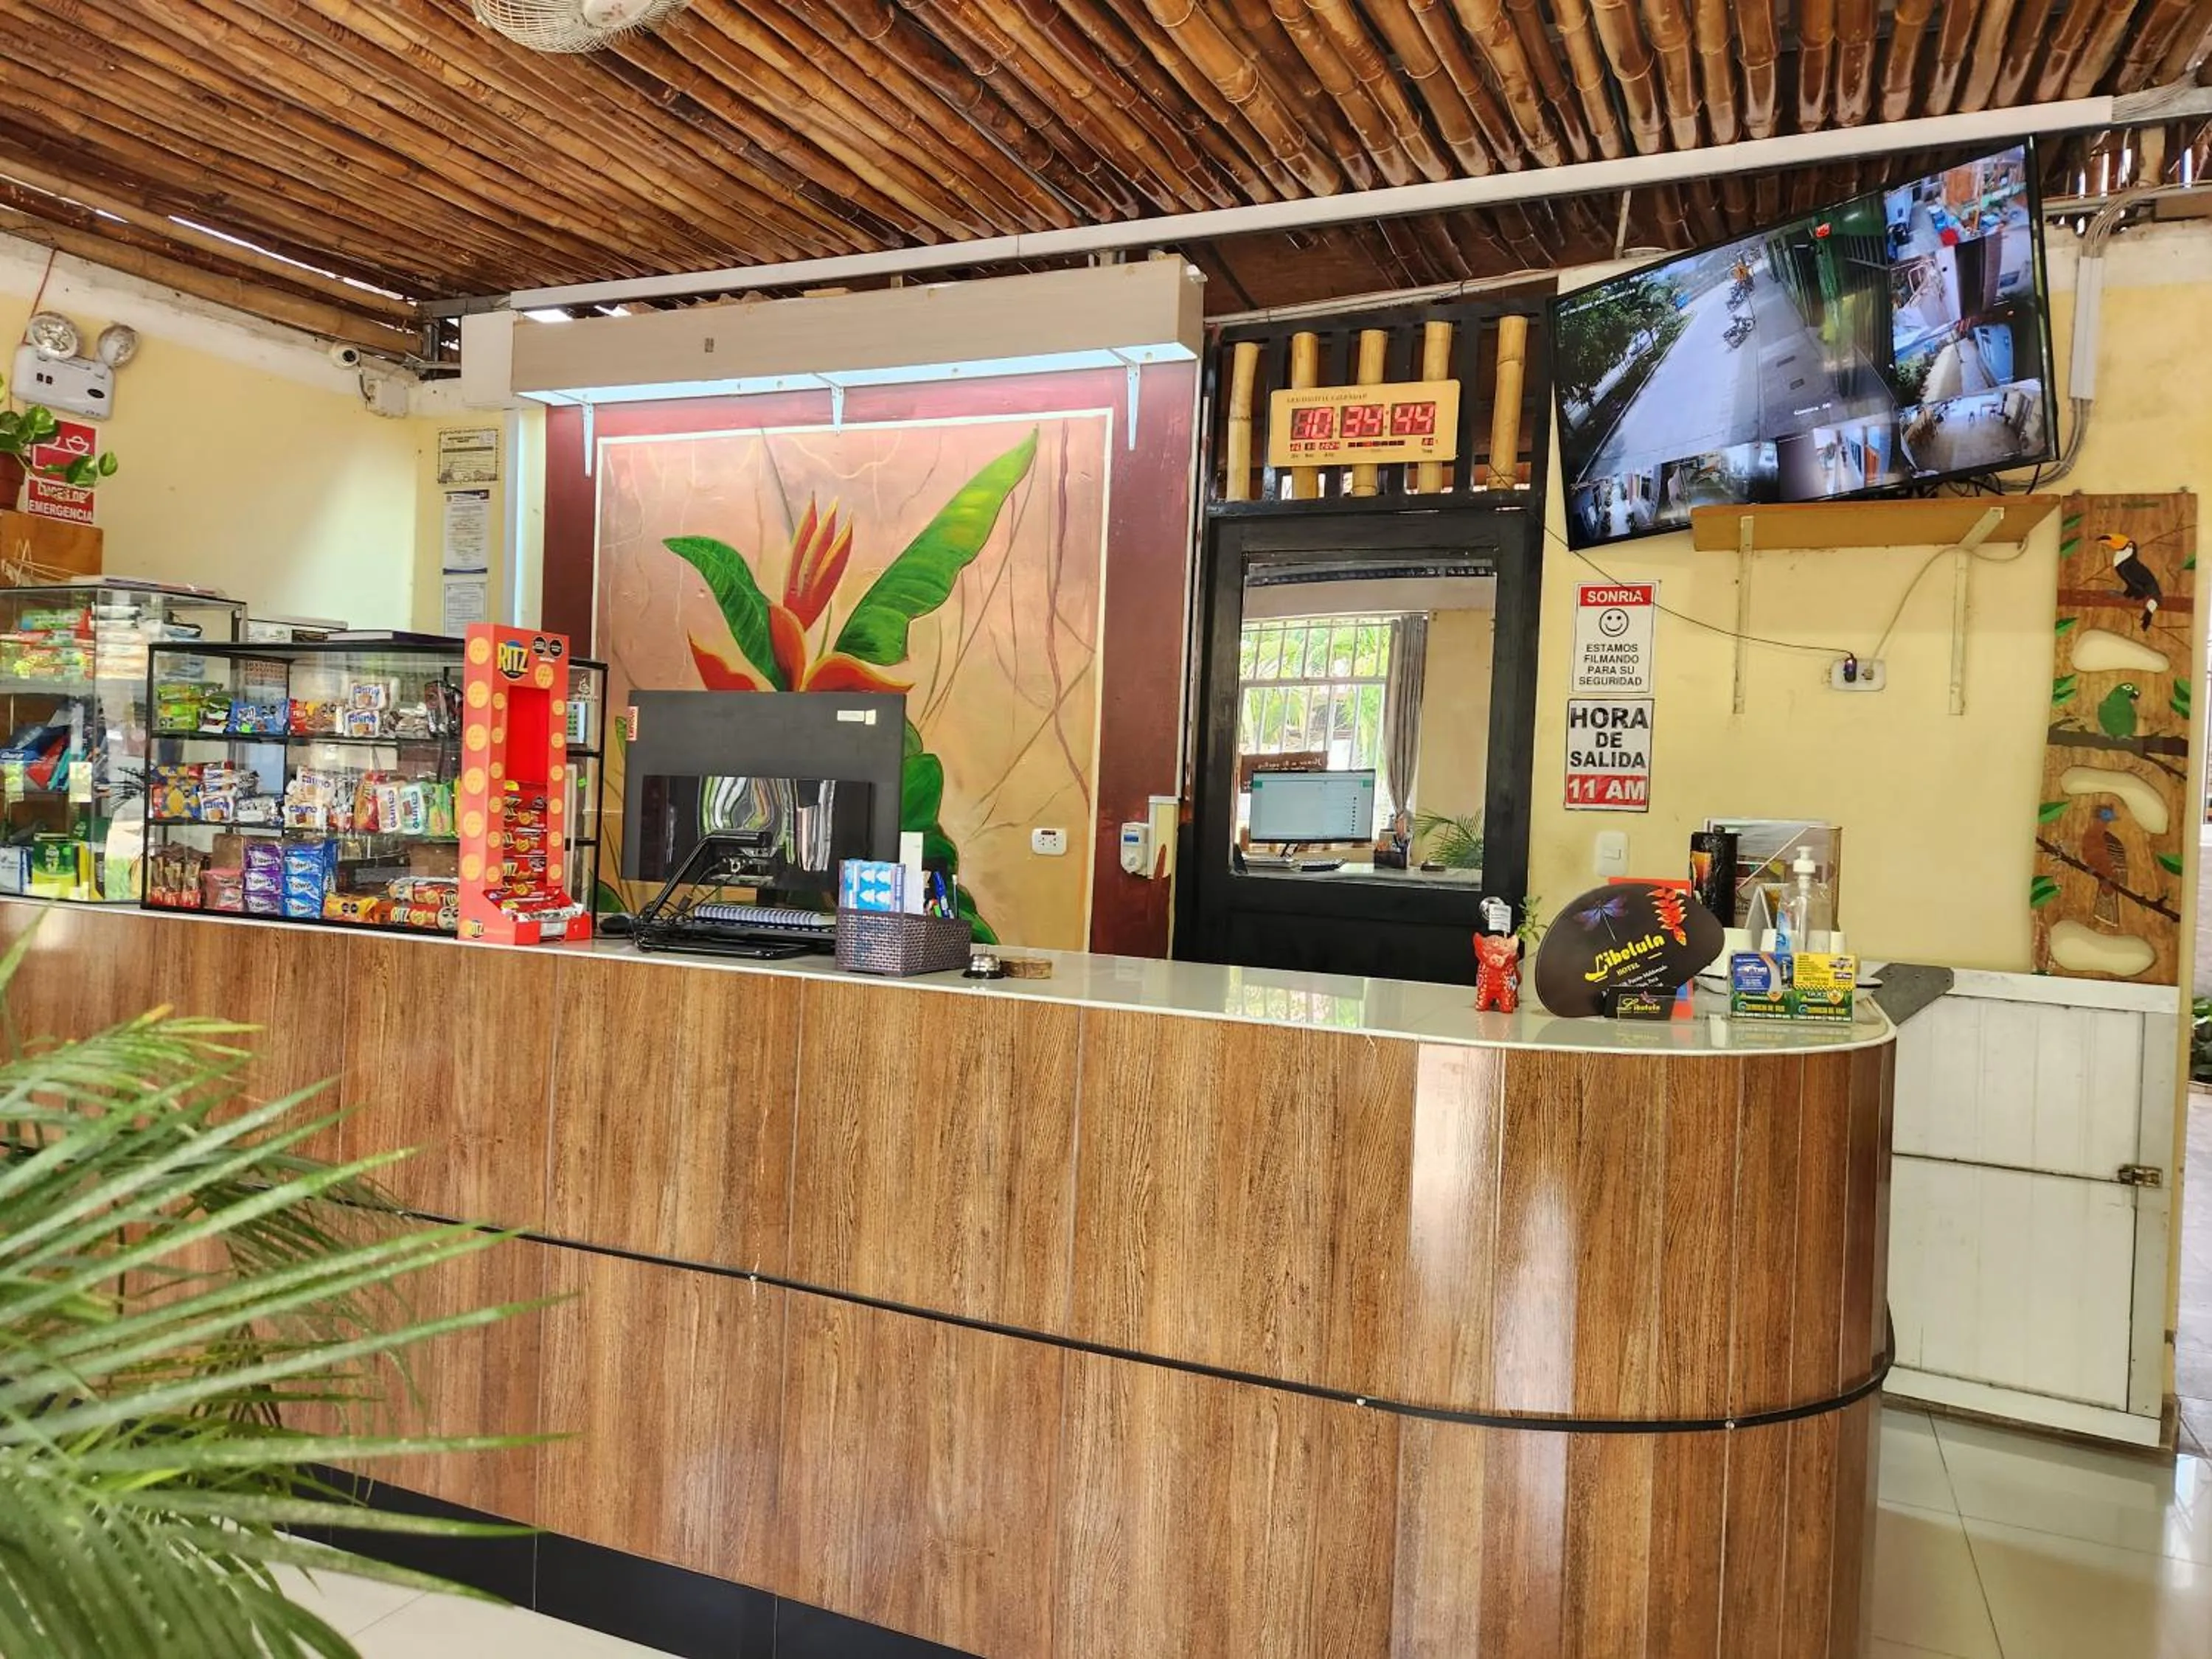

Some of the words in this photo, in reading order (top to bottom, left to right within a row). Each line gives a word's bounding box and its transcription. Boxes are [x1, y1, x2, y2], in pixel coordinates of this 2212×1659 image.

[29, 500, 93, 521] EMERGENCIA
[1586, 644, 1638, 653] ESTAMOS
[498, 642, 529, 673] RITZ
[1584, 655, 1639, 664] FILMANDO
[1587, 666, 1617, 675] PARA
[1619, 666, 1635, 675] SU
[1579, 676, 1642, 686] SEGURIDAD
[1570, 707, 1649, 728] HORA
[1596, 731, 1622, 748] DE
[1570, 751, 1646, 768] SALIDA
[1568, 778, 1596, 799] 11
[1605, 779, 1646, 801] AM
[1585, 934, 1665, 981] Libelula
[1616, 962, 1641, 976] HOTEL
